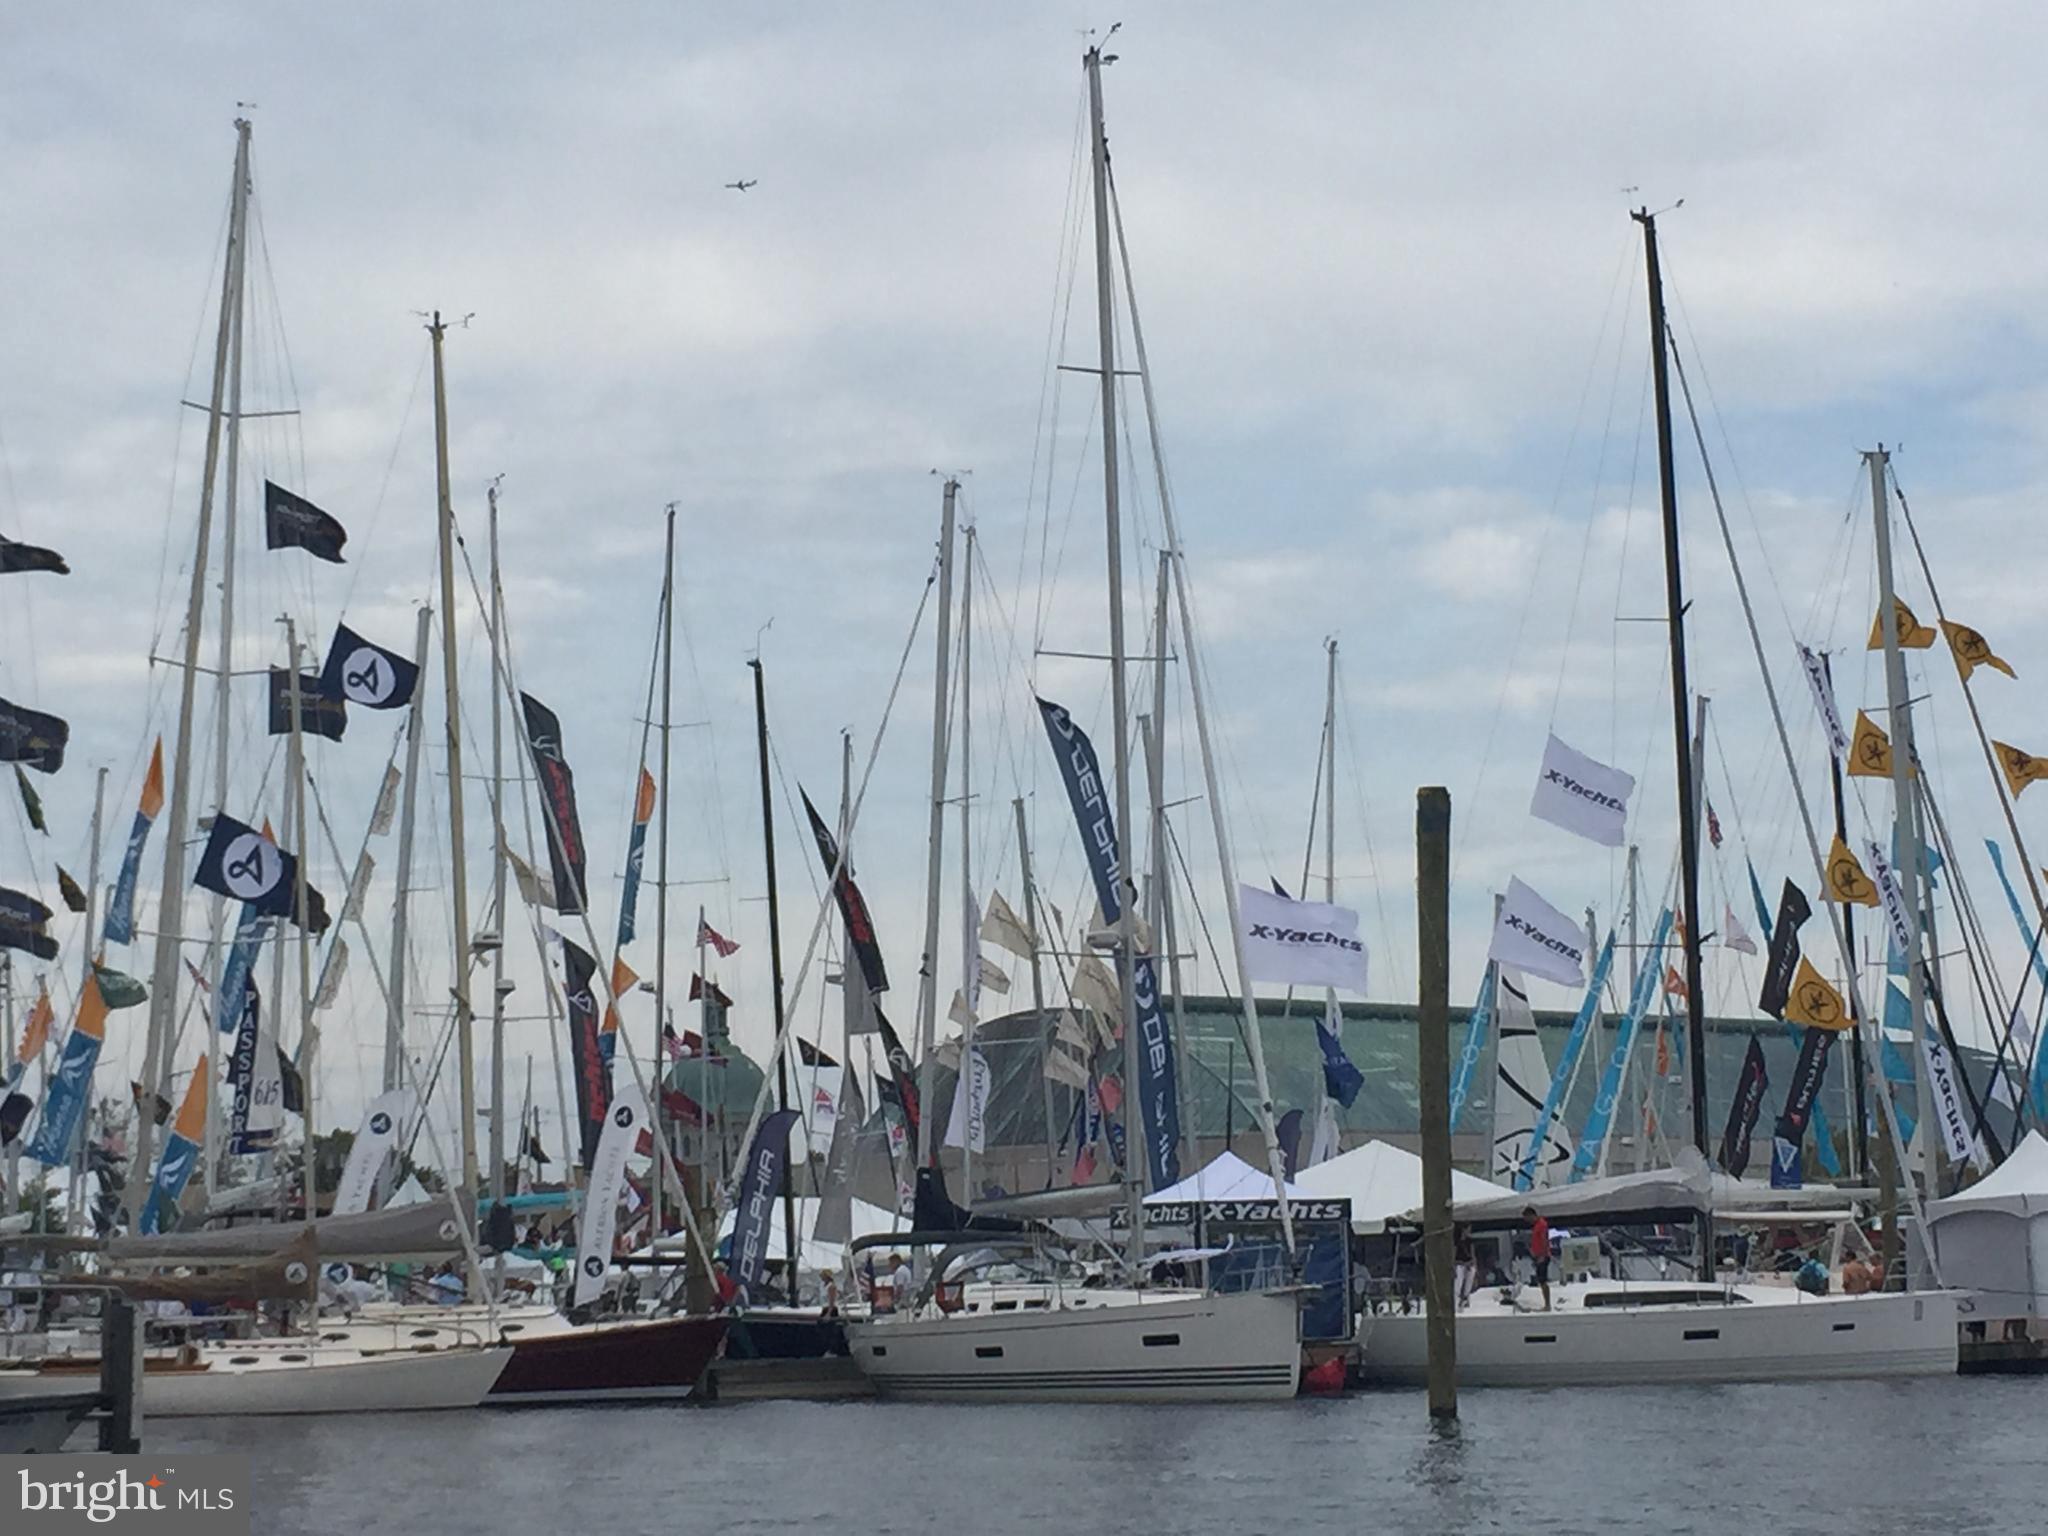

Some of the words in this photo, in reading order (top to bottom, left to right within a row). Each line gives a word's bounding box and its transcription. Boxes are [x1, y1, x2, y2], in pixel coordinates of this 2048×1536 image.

[1249, 923, 1363, 952] X-Yachts
[228, 990, 257, 1153] PASSPORT
[740, 1149, 775, 1283] DELPHIA
[1113, 1205, 1190, 1226] Xachts
[1203, 1203, 1343, 1221] X-Yachts
